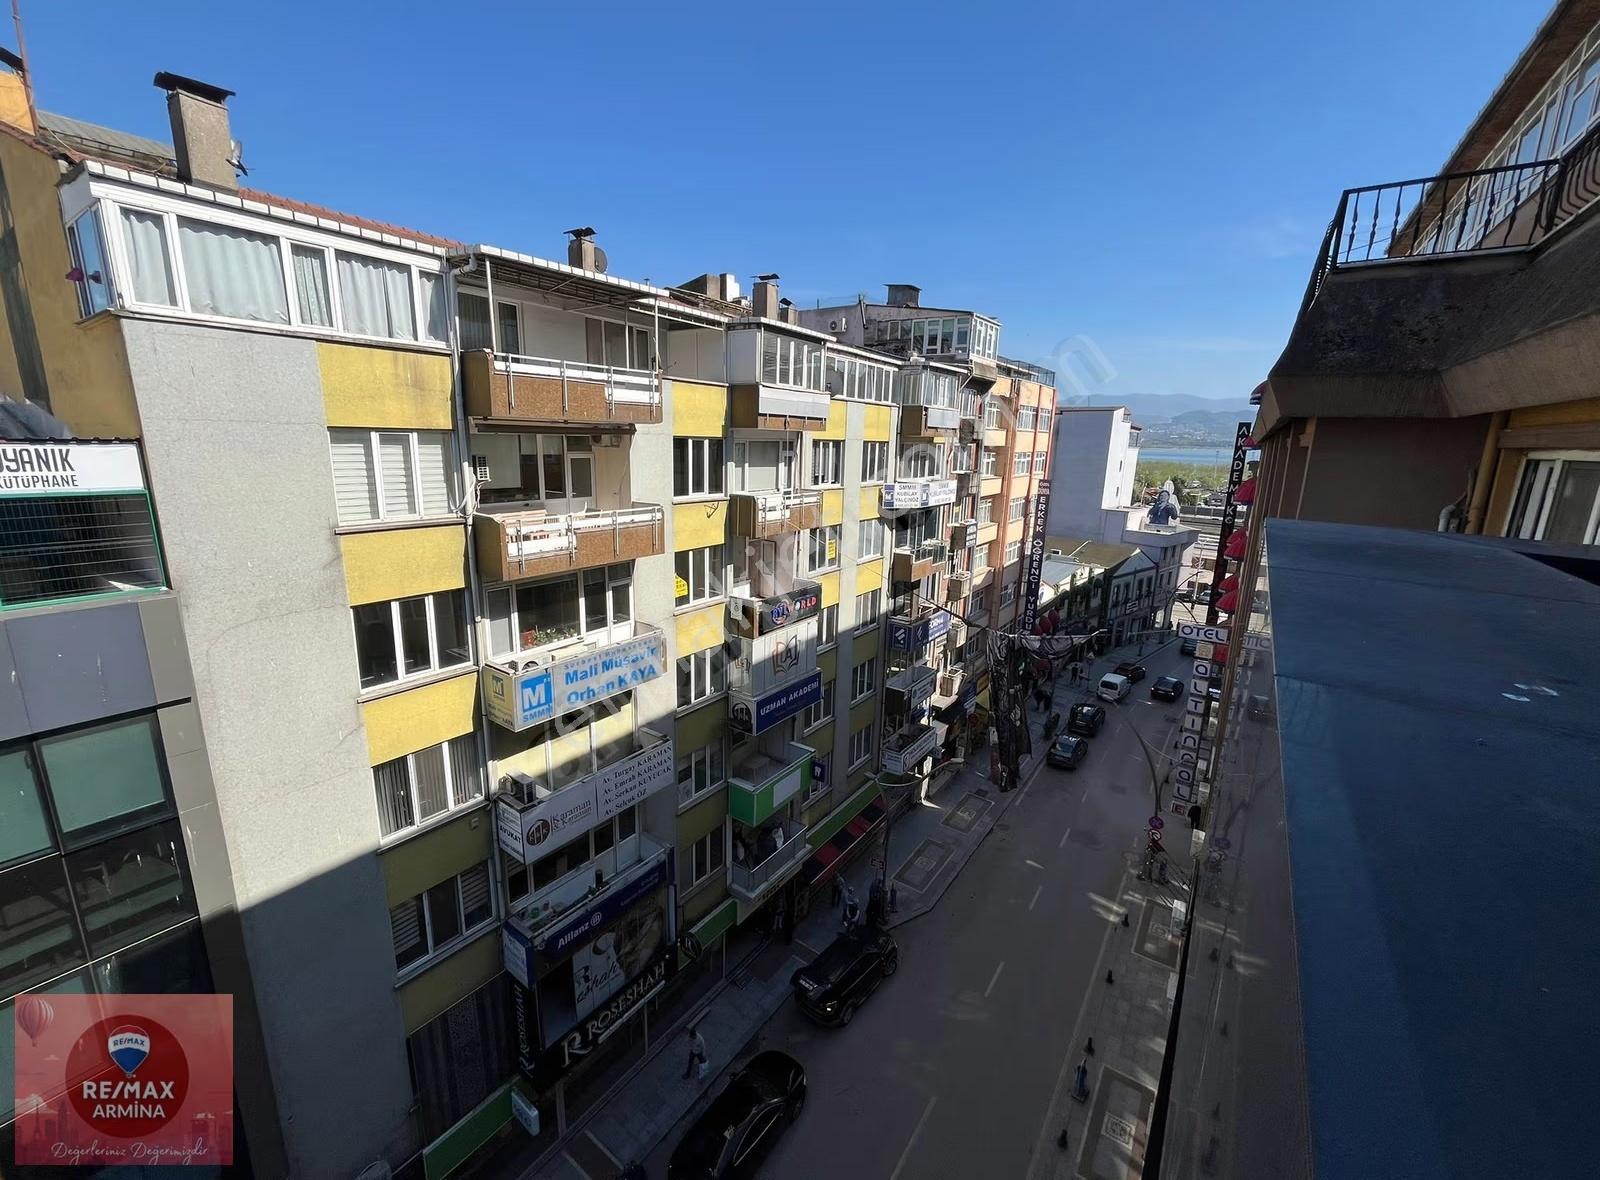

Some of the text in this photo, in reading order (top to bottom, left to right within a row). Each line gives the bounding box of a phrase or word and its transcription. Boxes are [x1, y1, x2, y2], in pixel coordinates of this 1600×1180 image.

[0, 447, 76, 473] YANIK
[1036, 496, 1046, 533] ERKEK
[1181, 624, 1227, 643] OTEL
[564, 666, 599, 686] Mali
[567, 663, 657, 705] Orhan KAYA
[760, 696, 787, 716] UZMAN
[788, 678, 819, 702] AKADEMİ
[636, 745, 672, 768] KARAMAN
[637, 755, 672, 778] KARAMAN
[551, 800, 591, 822] Karaman
[499, 824, 522, 844] AVUKAT
[557, 921, 590, 950] Allianz
